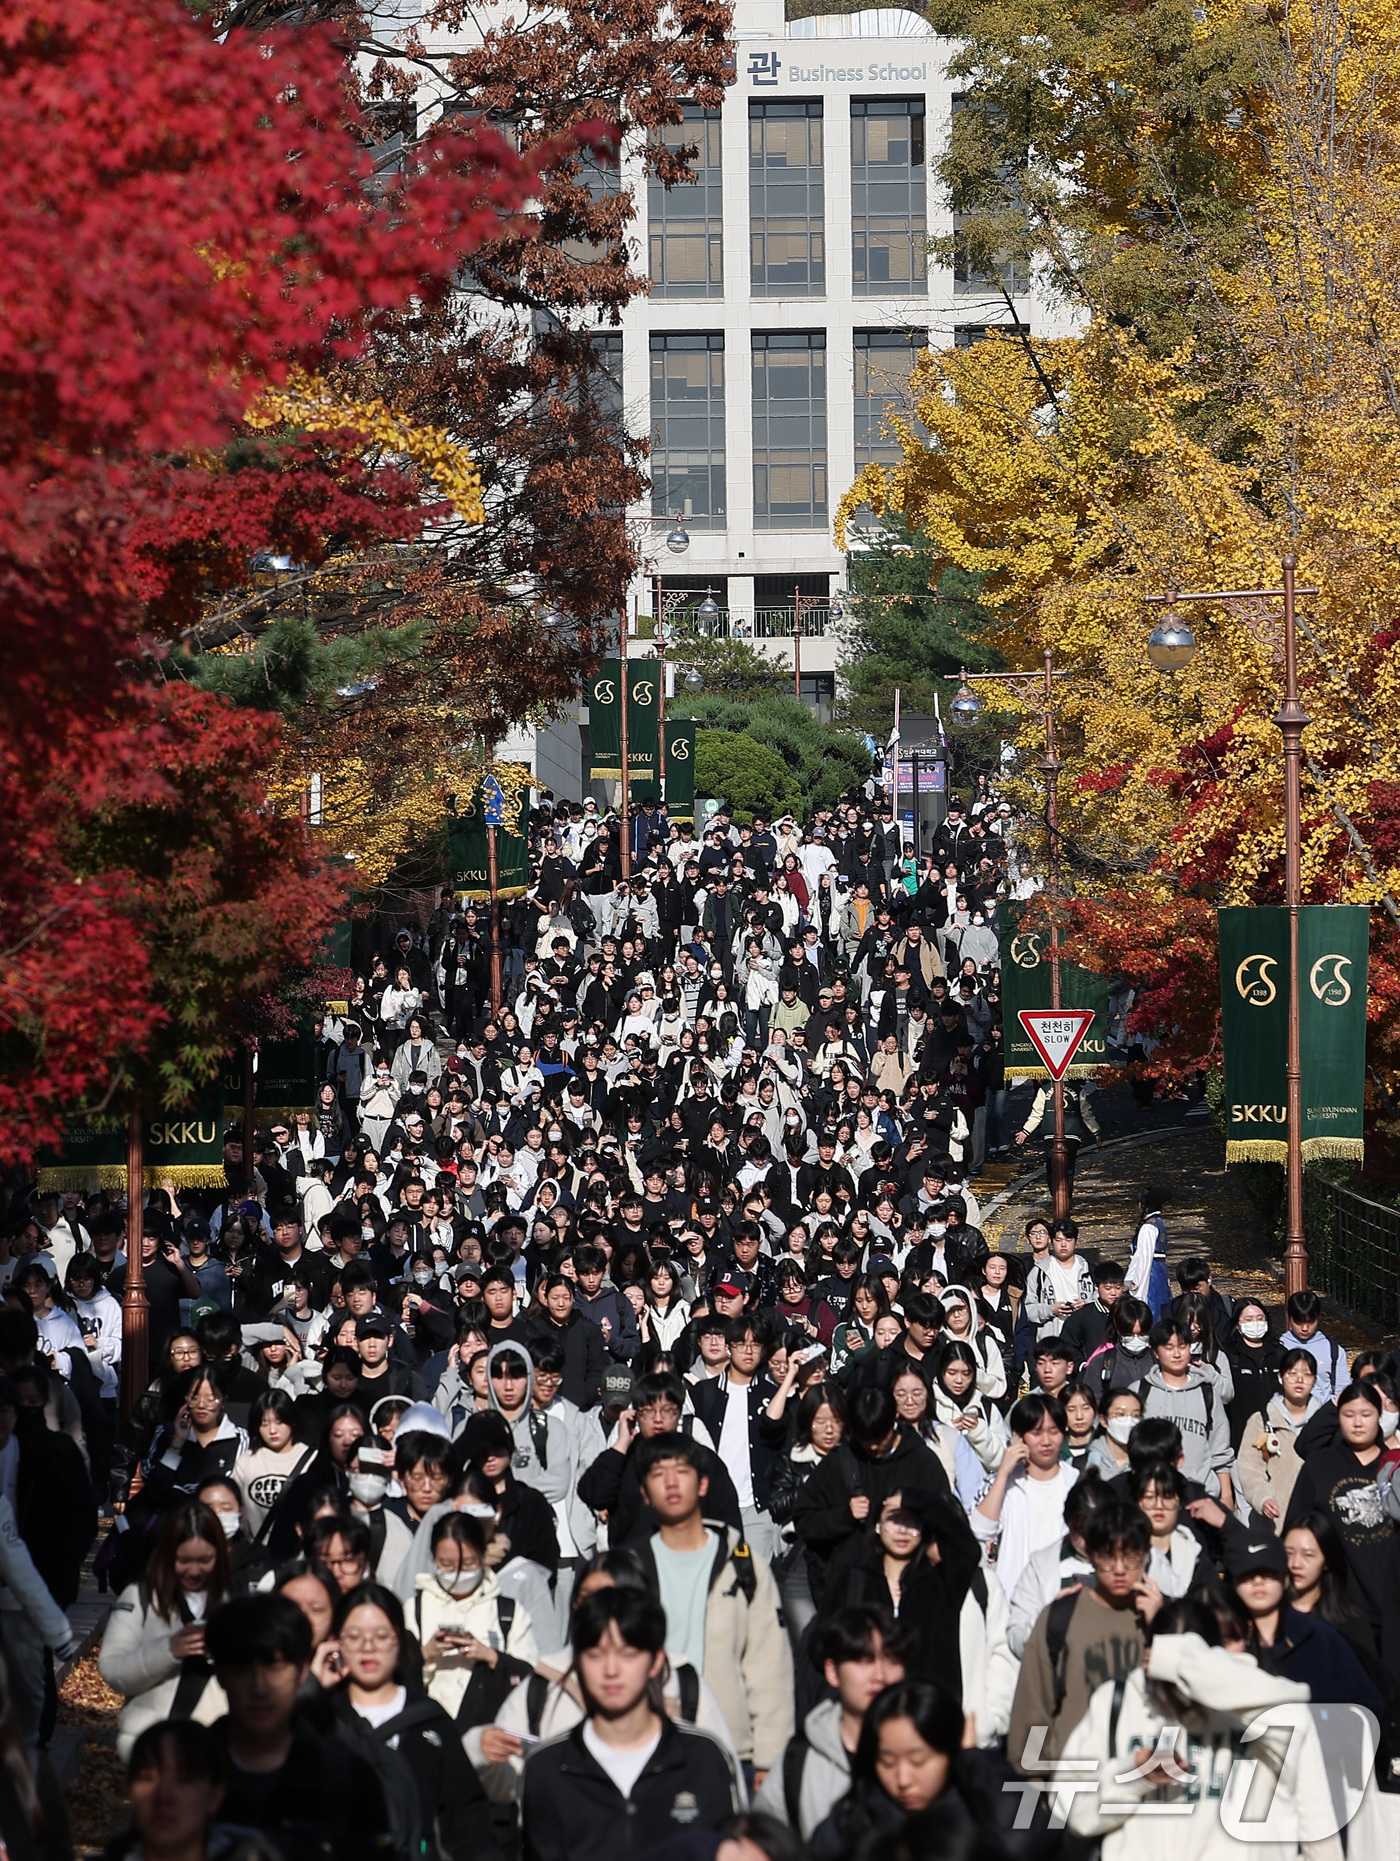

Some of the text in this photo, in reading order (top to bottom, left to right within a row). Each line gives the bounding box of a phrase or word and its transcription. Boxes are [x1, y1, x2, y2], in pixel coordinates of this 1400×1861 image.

[789, 65, 864, 82] Business
[868, 63, 927, 81] School
[456, 870, 488, 882] SKKU
[1252, 989, 1268, 997] 1398
[1040, 1020, 1074, 1034] 천천히
[1044, 1035, 1070, 1044] SLOW
[1077, 1039, 1106, 1053] KKU
[1231, 1104, 1288, 1123] SKKU
[149, 1121, 216, 1145] SKKU
[721, 1272, 732, 1283] D
